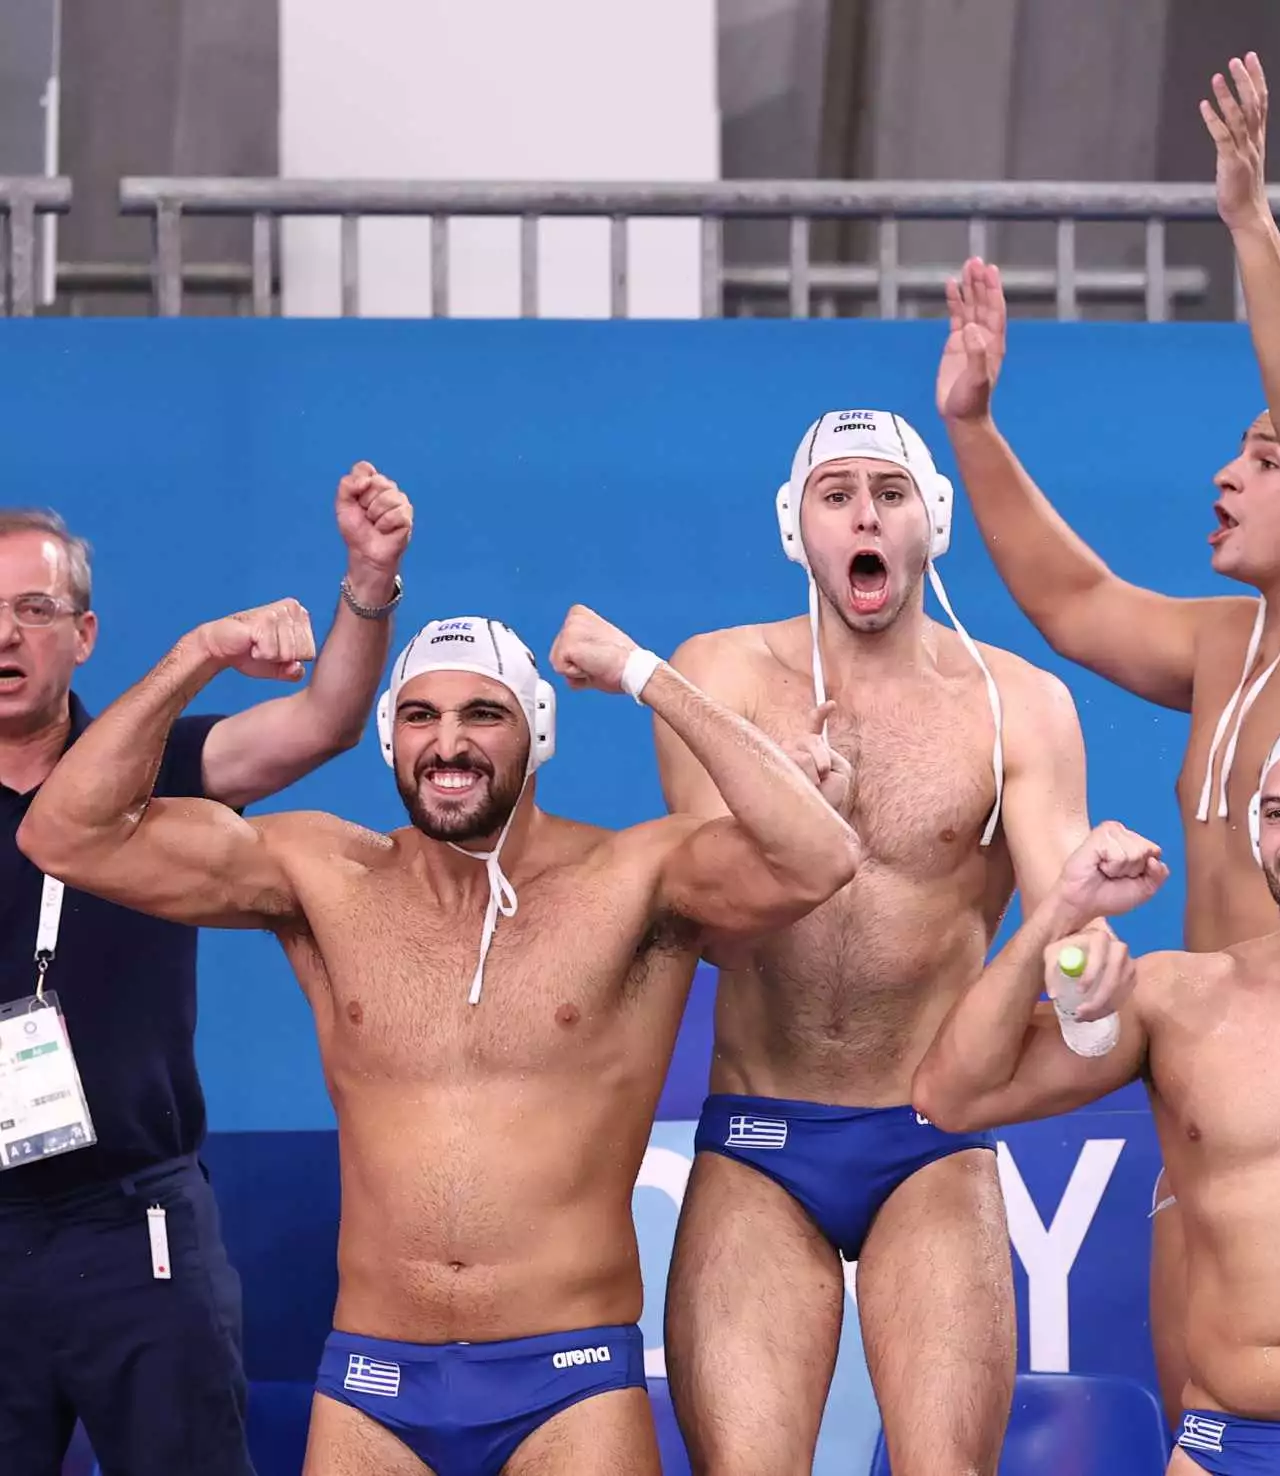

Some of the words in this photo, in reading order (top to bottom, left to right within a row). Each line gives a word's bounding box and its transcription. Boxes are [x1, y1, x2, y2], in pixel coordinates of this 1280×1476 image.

[838, 411, 874, 421] GRE
[833, 422, 877, 433] arena
[437, 621, 474, 631] GRE
[430, 634, 475, 645] arena
[552, 1346, 611, 1369] arena
